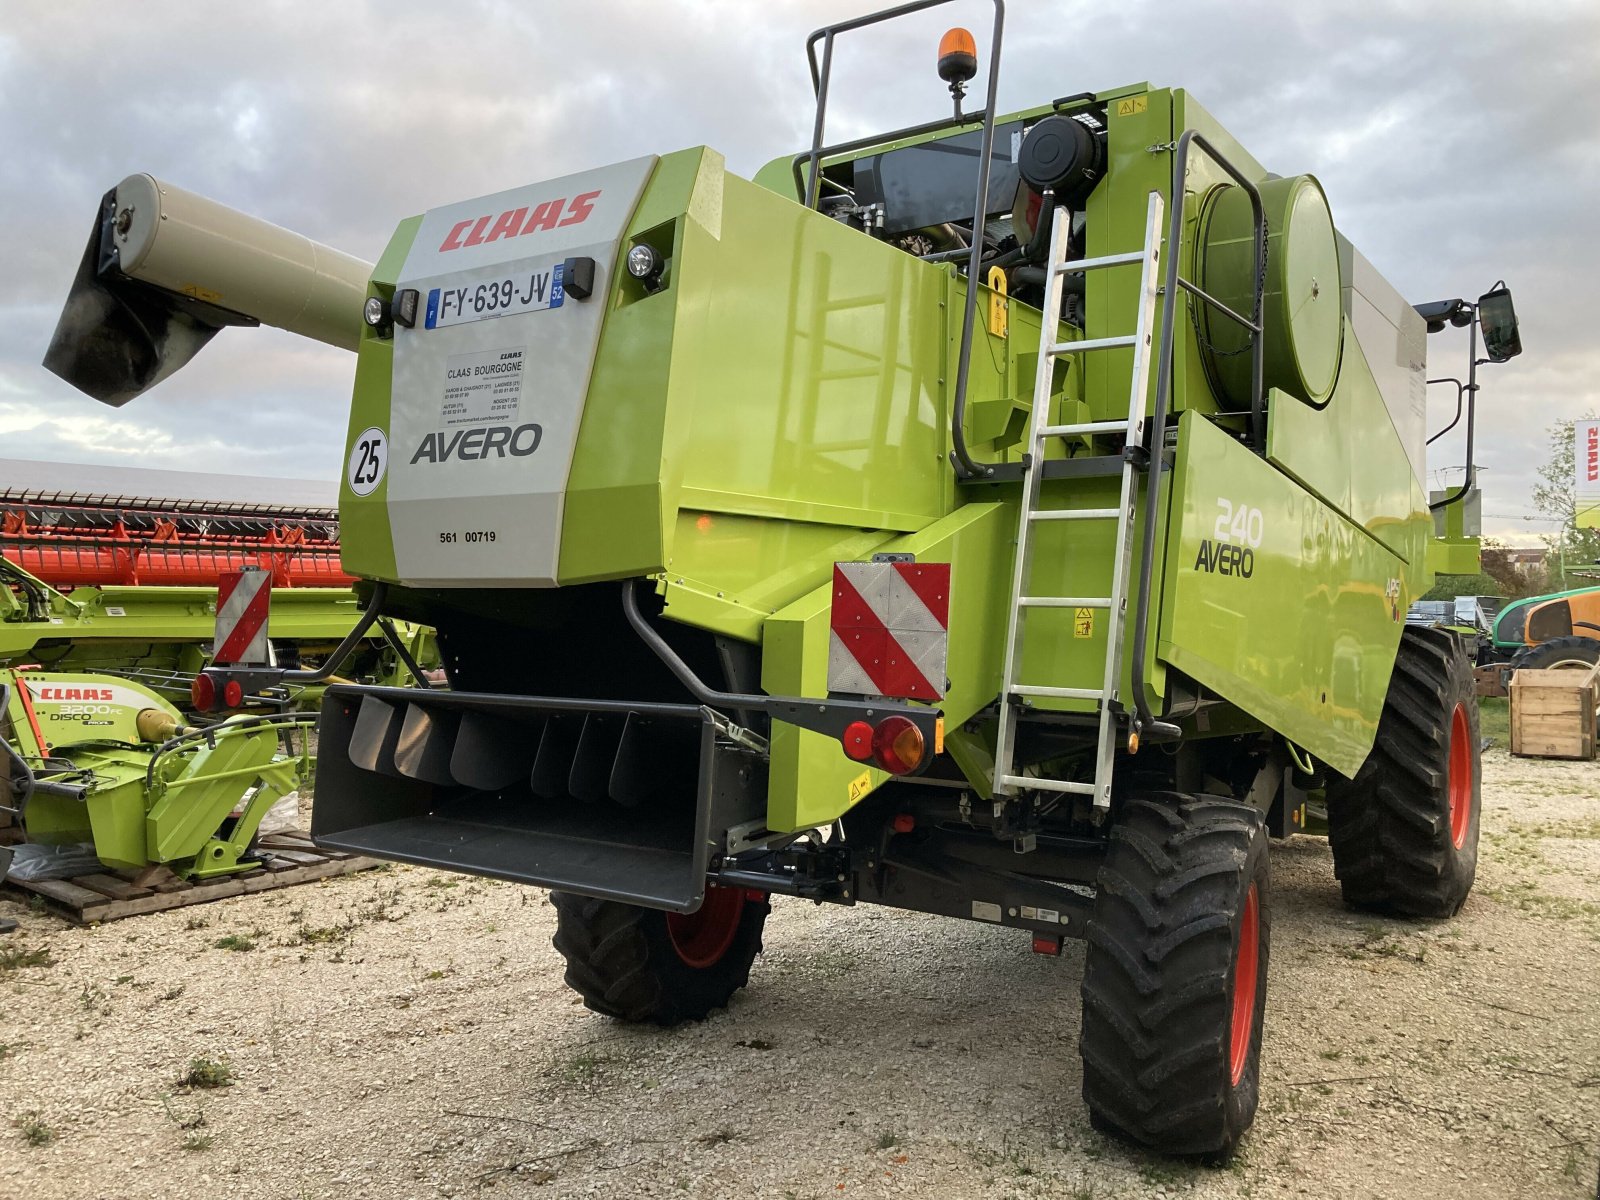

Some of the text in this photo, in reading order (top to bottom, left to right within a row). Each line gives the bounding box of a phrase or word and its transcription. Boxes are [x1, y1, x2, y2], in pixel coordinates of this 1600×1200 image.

[439, 190, 602, 252] CLAAS
[441, 272, 549, 319] FY-639-JV
[552, 286, 562, 300] 52
[448, 368, 471, 378] CLAAS
[474, 361, 522, 376] BOURGOGNE
[500, 352, 522, 360] CLAAS
[410, 424, 542, 464] AVERO
[354, 440, 380, 484] 25
[1214, 497, 1264, 548] 240
[440, 532, 496, 543] 561 00719
[1194, 540, 1254, 578] AVERO
[41, 688, 112, 700] CLAAS
[60, 705, 110, 714] 3200
